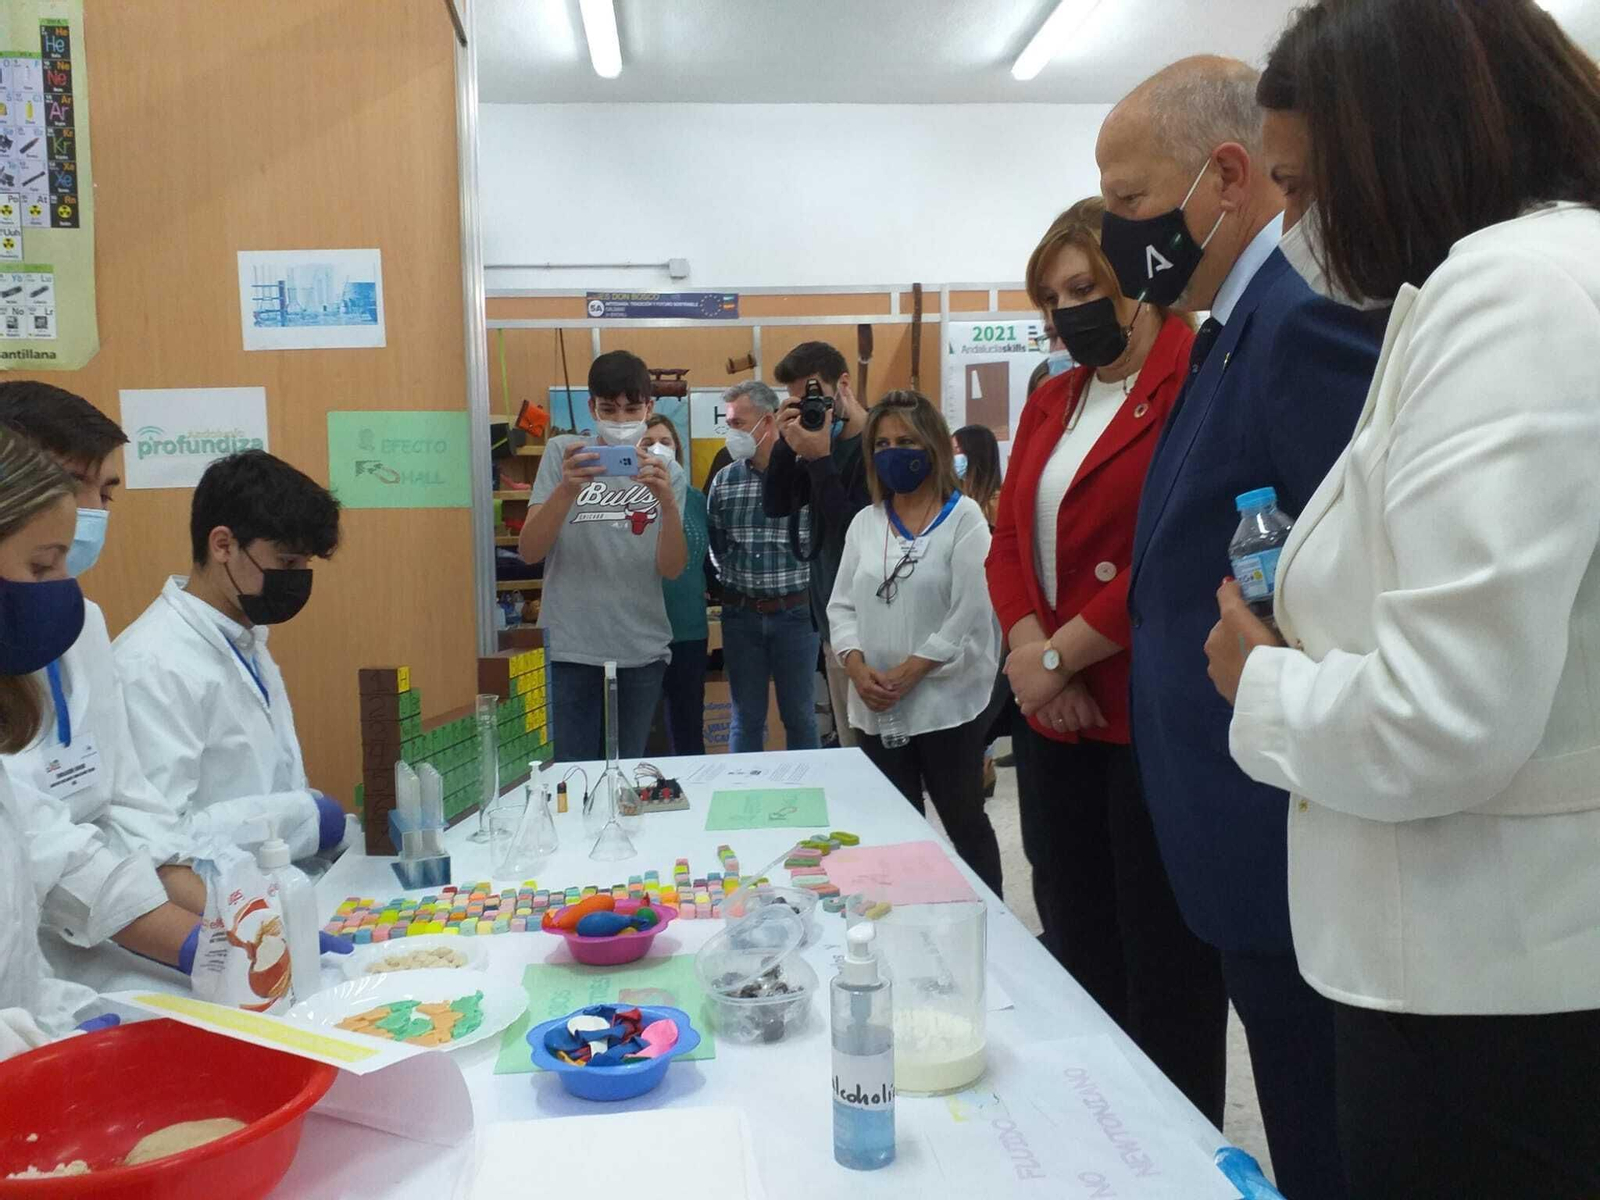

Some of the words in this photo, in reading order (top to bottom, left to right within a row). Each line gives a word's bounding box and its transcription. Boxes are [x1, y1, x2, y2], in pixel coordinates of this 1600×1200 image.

[46, 36, 65, 53] He
[47, 70, 67, 87] Ne
[50, 101, 69, 121] Ar
[53, 137, 72, 154] Kr
[55, 171, 73, 188] Xe
[12, 307, 25, 316] No
[972, 325, 1017, 342] 2021
[0, 348, 57, 360] antillana
[137, 434, 264, 460] profundiza
[381, 440, 447, 454] EFECTO
[401, 471, 446, 485] HALL
[576, 482, 659, 507] Bulls
[832, 1075, 895, 1105] lcoholi
[1077, 1171, 1117, 1199] NO
